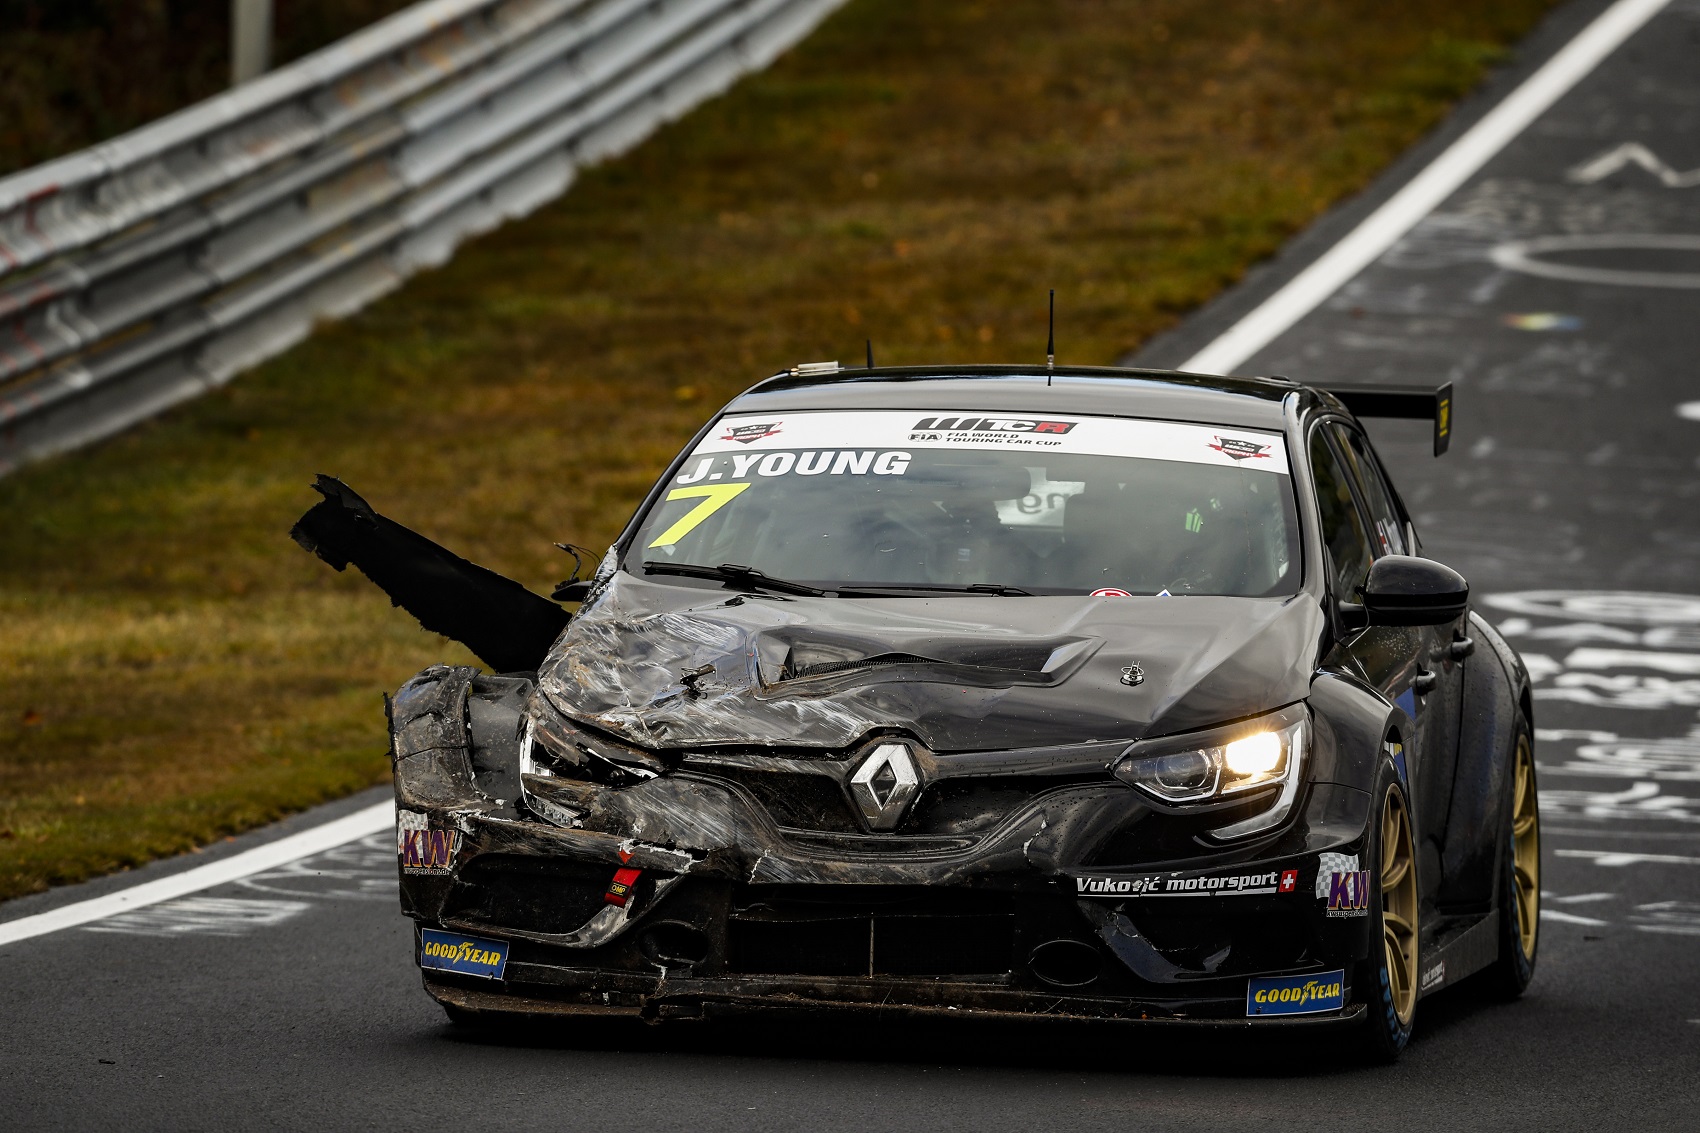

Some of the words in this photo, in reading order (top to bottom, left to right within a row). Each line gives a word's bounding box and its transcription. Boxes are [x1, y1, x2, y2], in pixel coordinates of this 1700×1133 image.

[909, 433, 939, 441] FIA
[912, 417, 1078, 434] WTCR
[676, 451, 912, 485] J.YOUNG
[648, 482, 751, 548] 7
[404, 829, 455, 867] KW
[1166, 871, 1278, 891] motorsport
[1326, 870, 1371, 910] KW
[425, 941, 501, 966] GOODYEAR
[1254, 981, 1340, 1005] GOODYEAR
